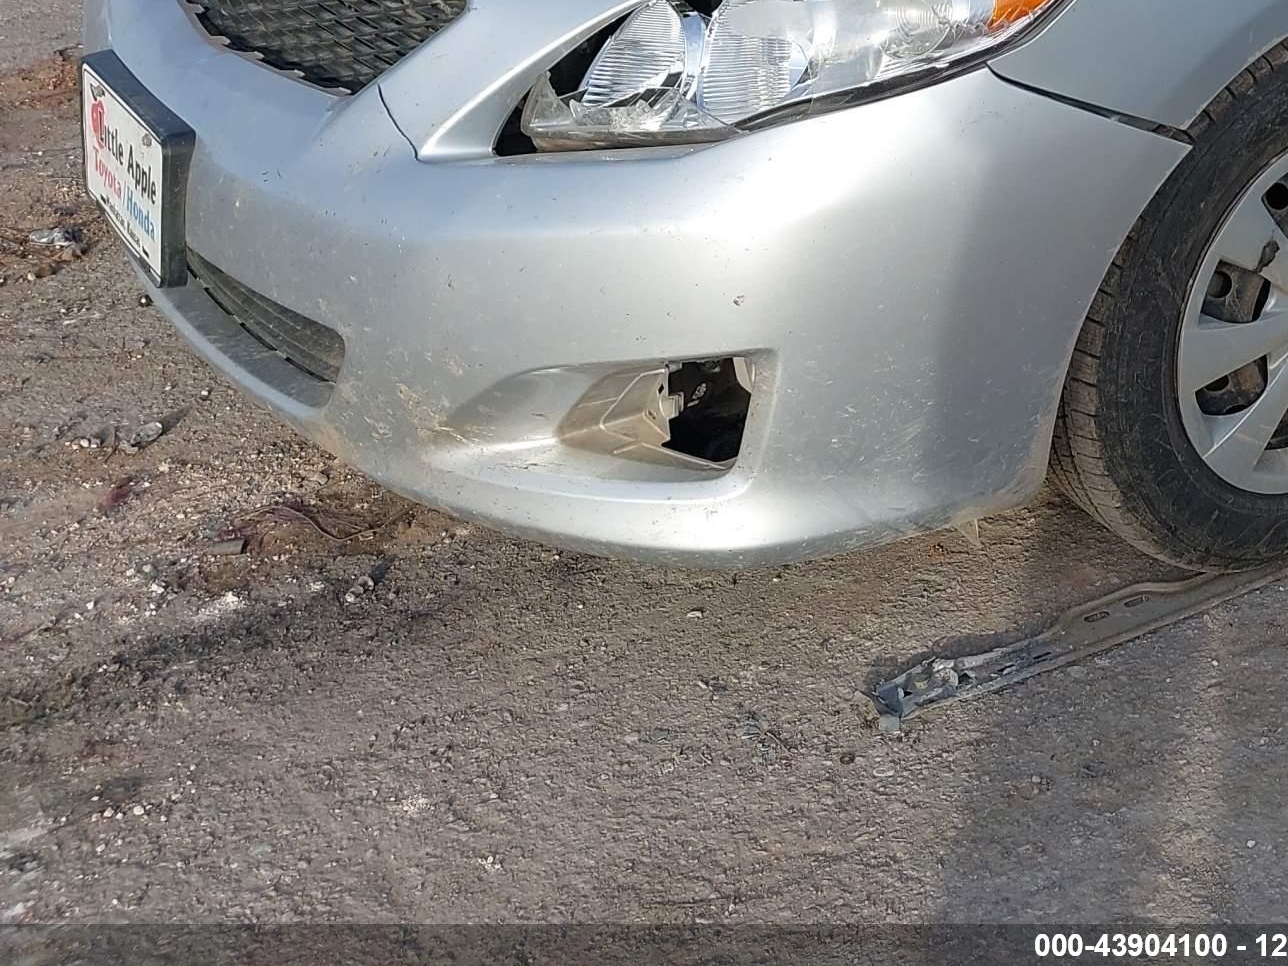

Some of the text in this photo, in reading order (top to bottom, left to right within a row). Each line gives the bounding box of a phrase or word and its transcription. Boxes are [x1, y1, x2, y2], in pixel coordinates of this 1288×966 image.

[92, 145, 122, 200] Toyota
[126, 185, 155, 243] Honda
[98, 108, 157, 205] Little Apple
